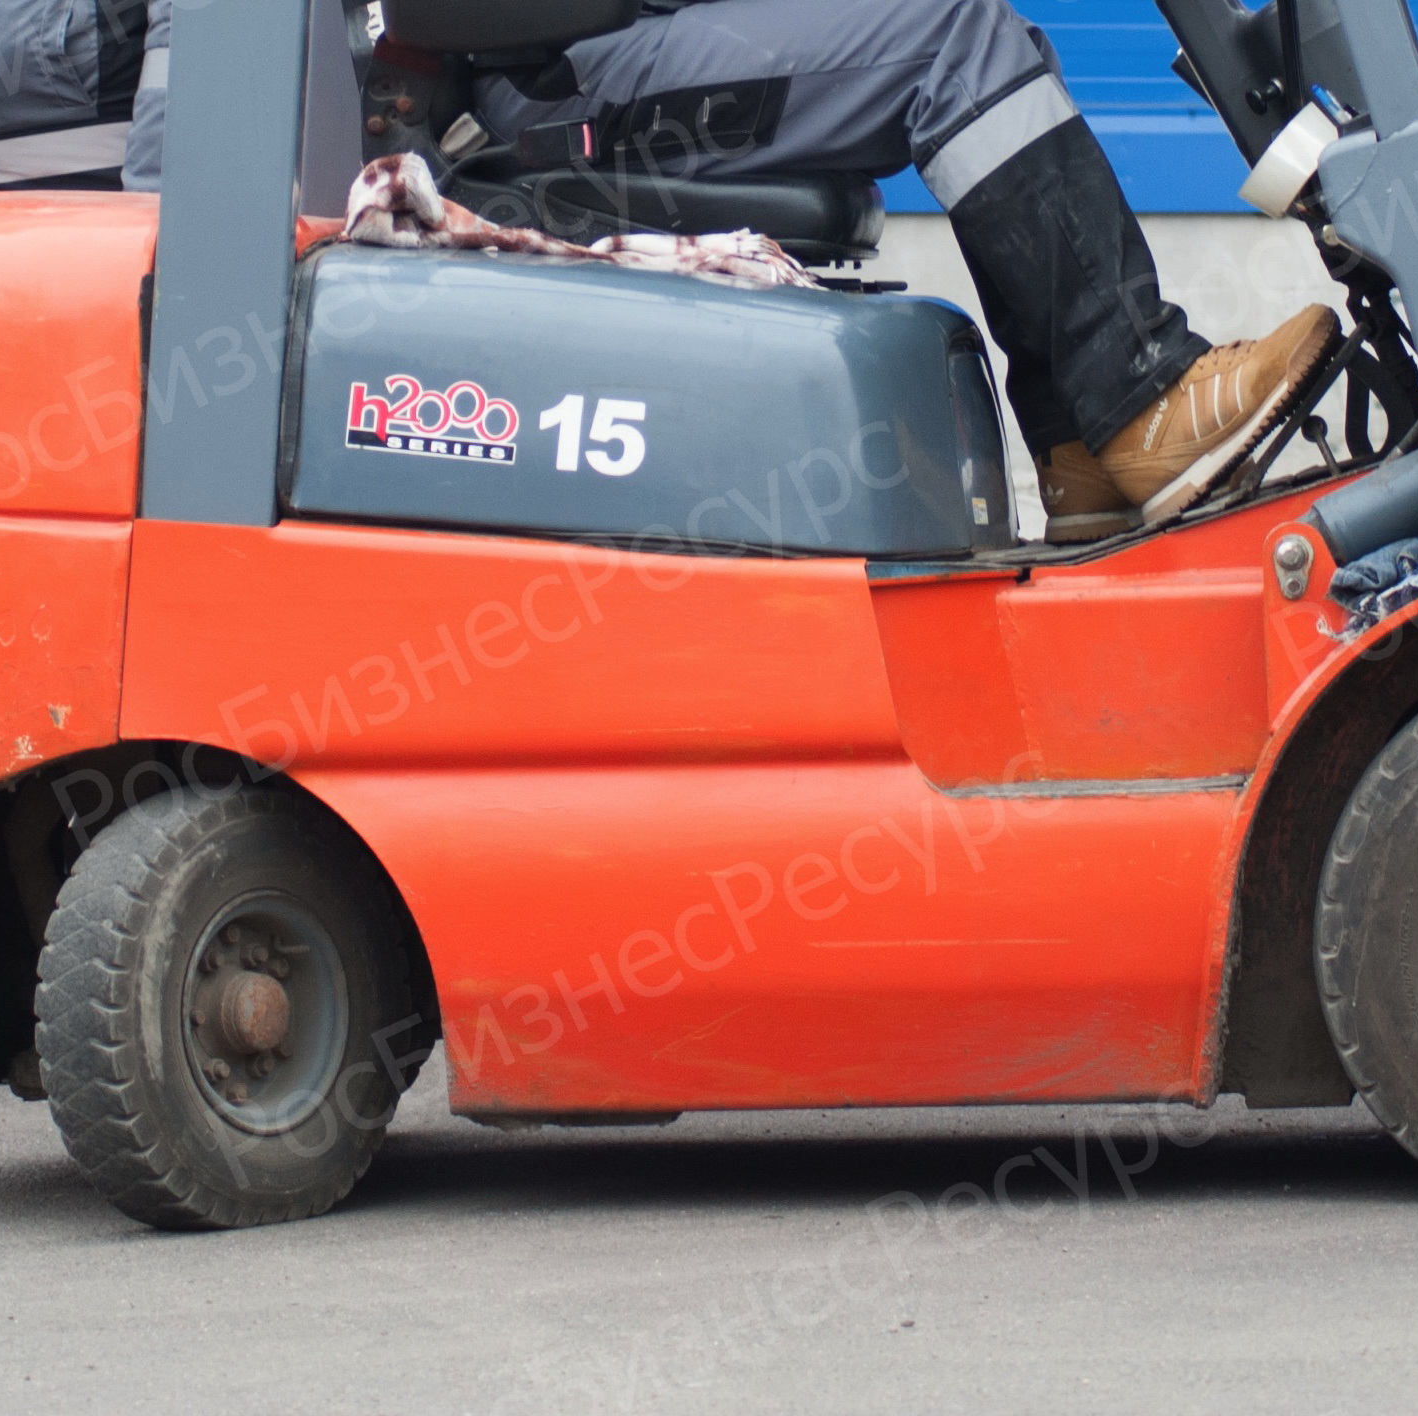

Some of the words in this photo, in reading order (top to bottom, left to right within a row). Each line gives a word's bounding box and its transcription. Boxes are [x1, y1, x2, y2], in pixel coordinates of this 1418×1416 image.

[346, 374, 520, 443] h2000
[538, 394, 647, 477] 15
[1142, 411, 1164, 452] adidas
[386, 436, 506, 461] SERIES
